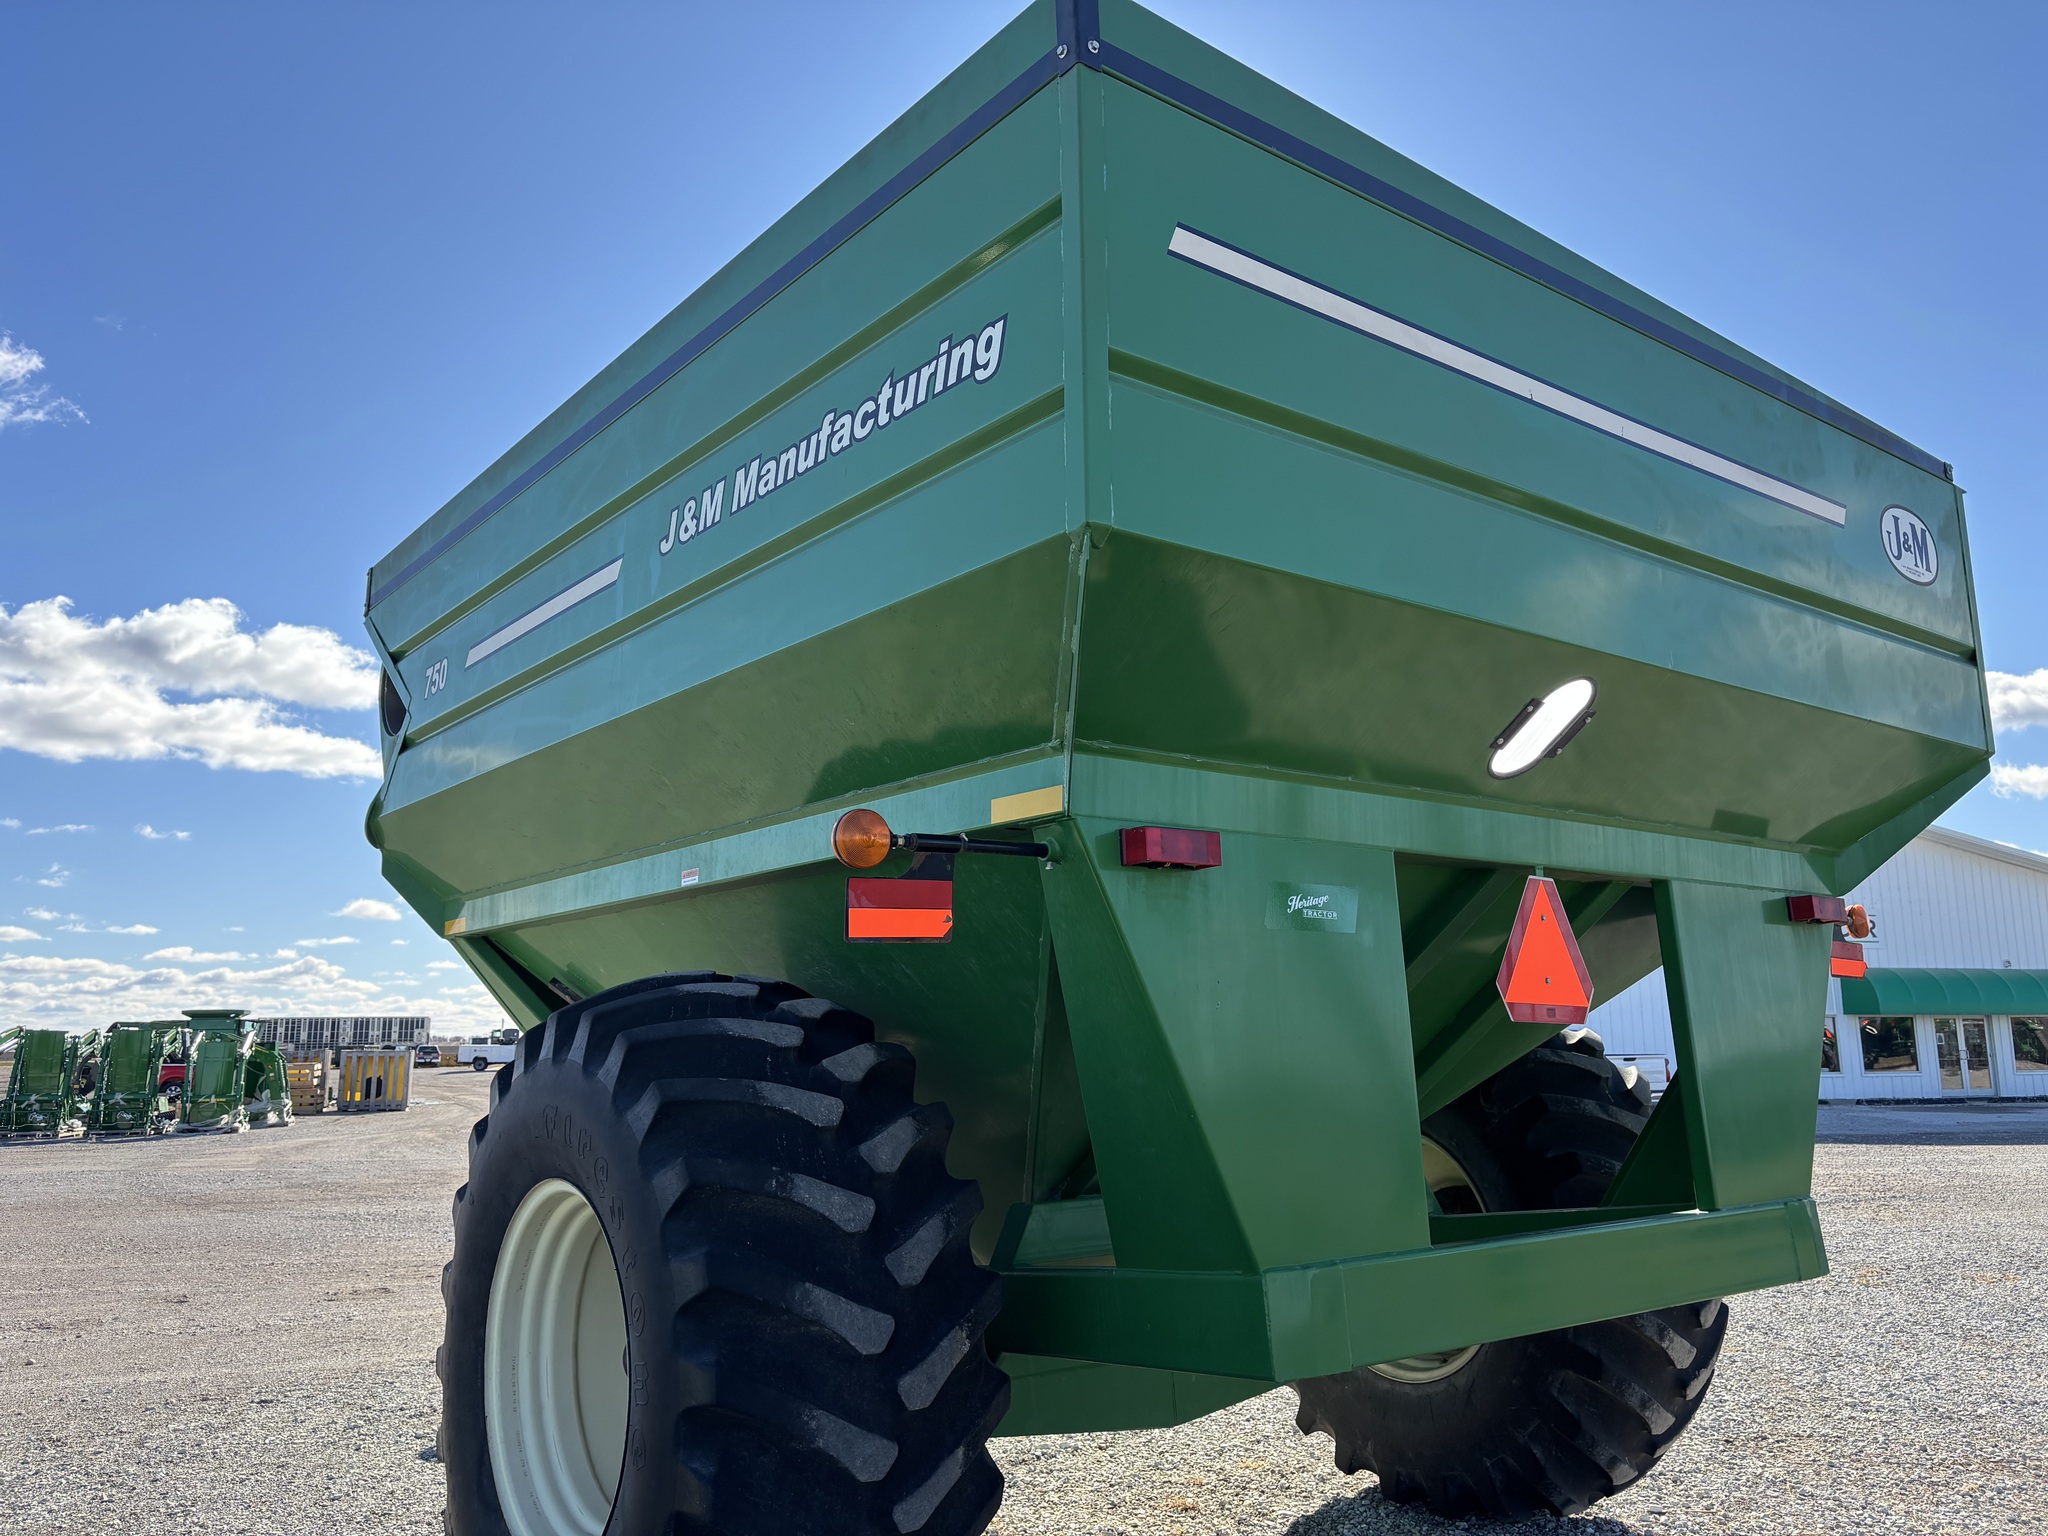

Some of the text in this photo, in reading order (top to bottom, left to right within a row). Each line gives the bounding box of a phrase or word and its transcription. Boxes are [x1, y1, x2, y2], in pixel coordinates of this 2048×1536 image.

[659, 314, 1008, 556] J&M Manufacturing
[1886, 514, 1932, 574] J&M
[424, 657, 448, 699] 750
[1287, 893, 1329, 913] Heritage
[1303, 909, 1338, 919] TRACTOR
